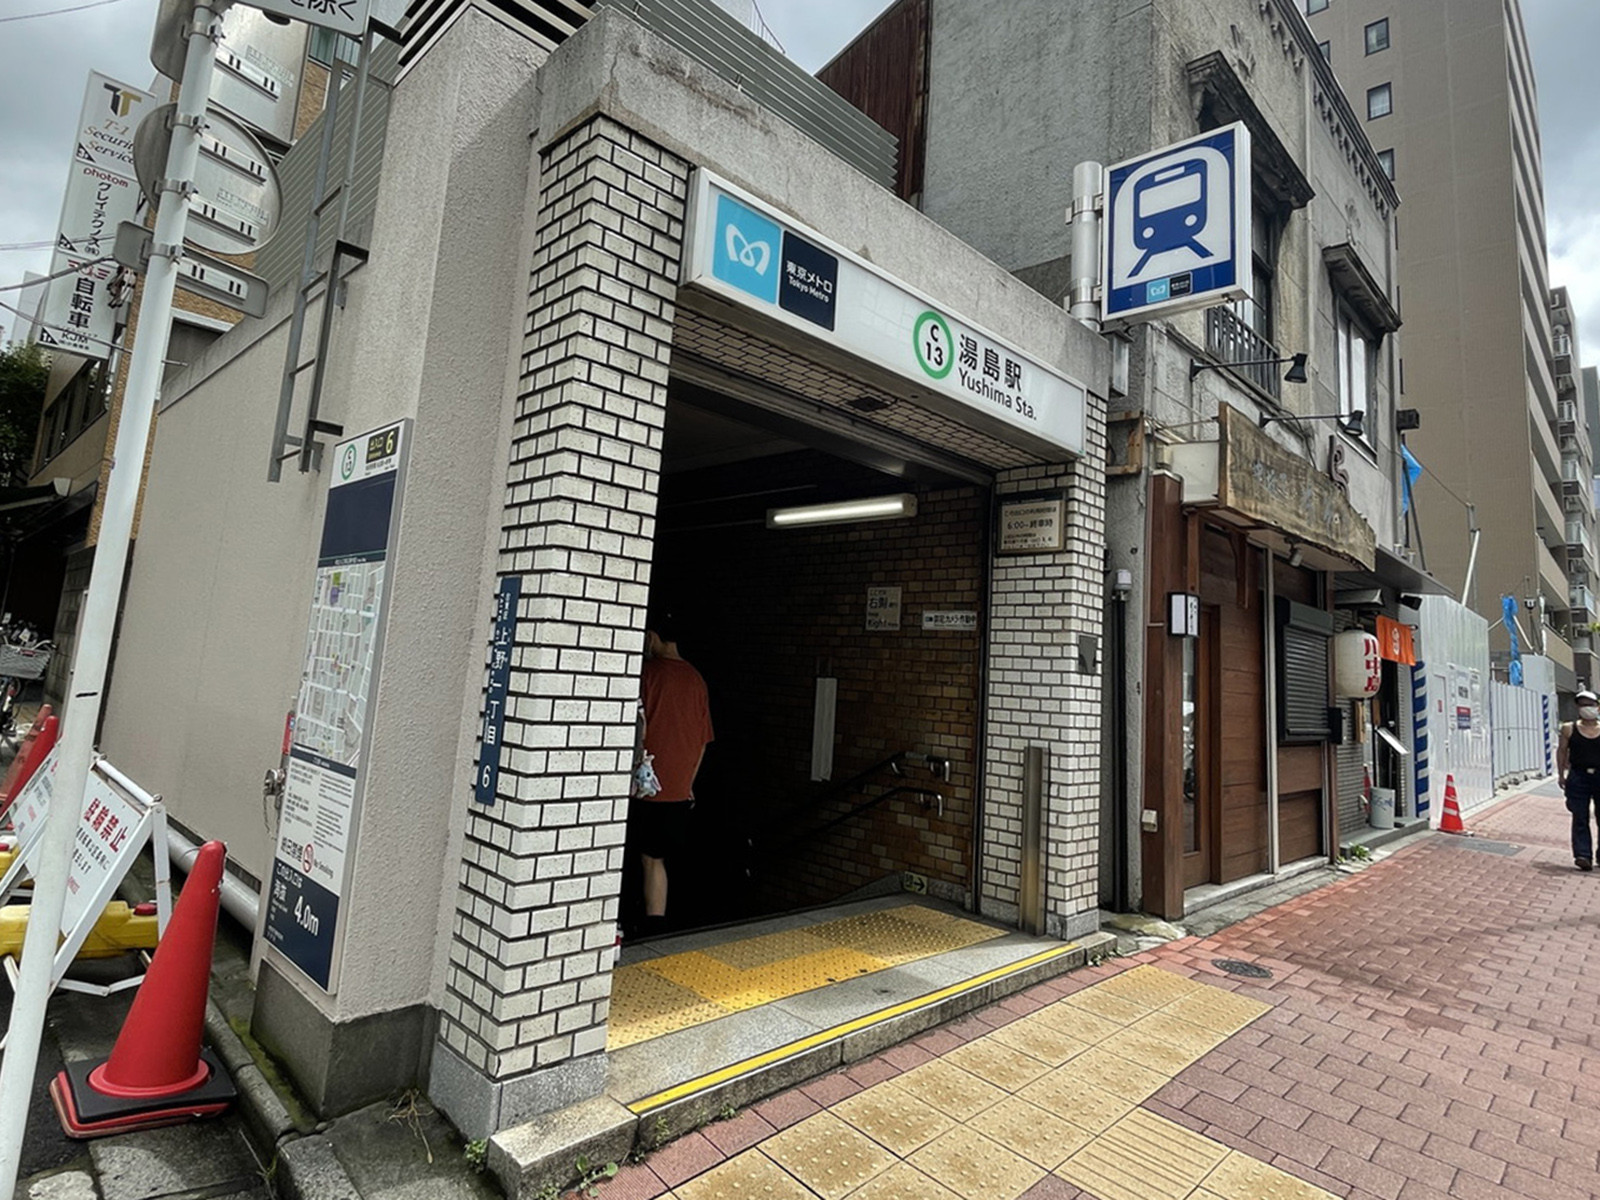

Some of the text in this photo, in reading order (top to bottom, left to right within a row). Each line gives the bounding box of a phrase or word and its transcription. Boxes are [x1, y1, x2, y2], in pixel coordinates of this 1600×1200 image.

[290, 0, 358, 21] 除く
[83, 167, 129, 188] photom
[786, 260, 833, 294] 東京メトロ
[789, 275, 830, 303] Tokyo Metro
[67, 277, 96, 329] 自転車
[930, 324, 939, 342] C
[926, 342, 944, 367] 13
[958, 333, 1022, 393] 湯島駅
[958, 367, 1038, 421] Yushima Sta.
[385, 430, 395, 454] 6
[1363, 638, 1381, 692] 川中島
[487, 626, 509, 745] 上野一丁目
[482, 765, 491, 788] 6
[294, 895, 320, 936] 4.0m
